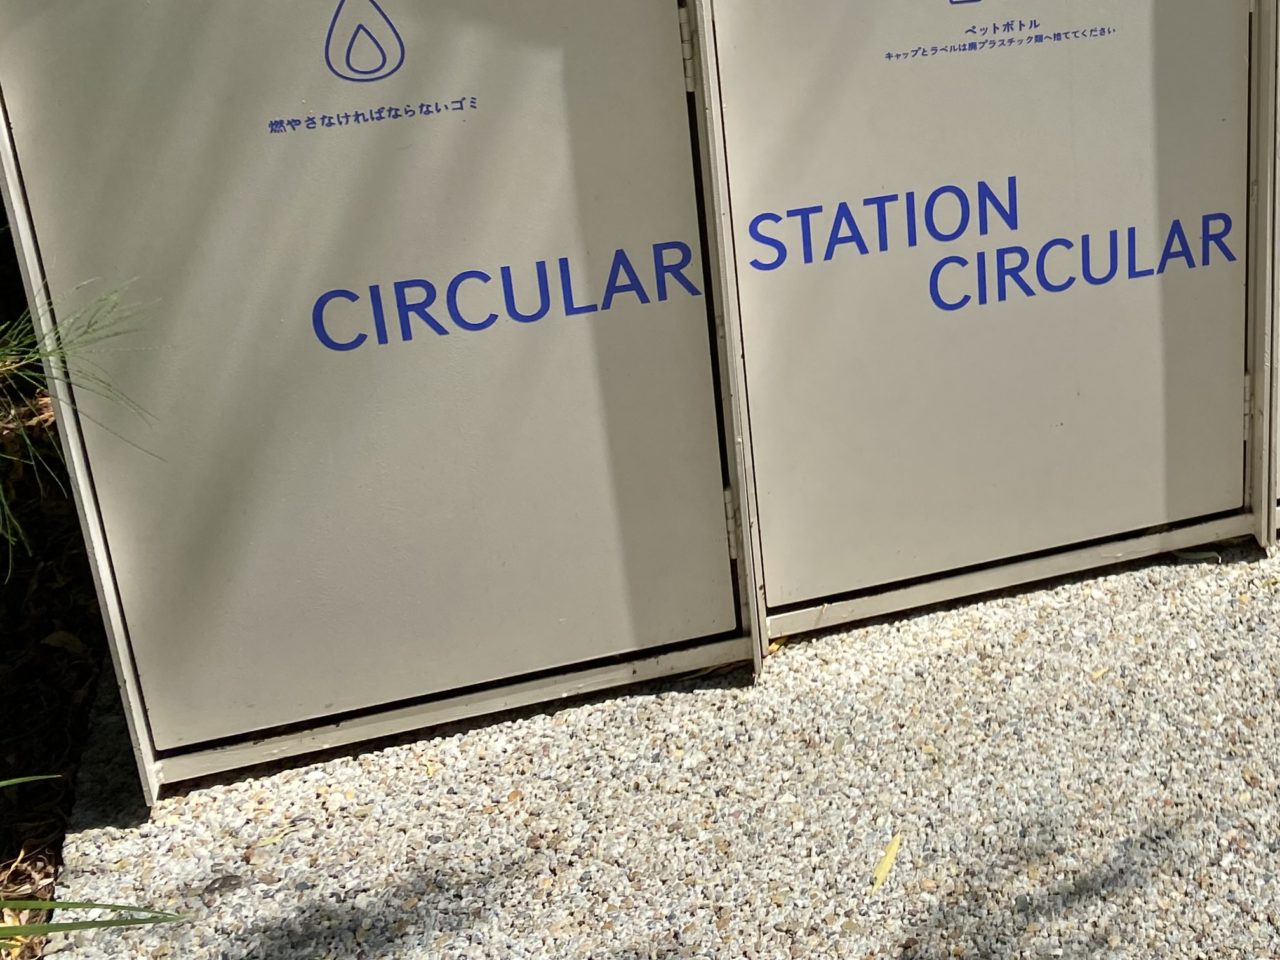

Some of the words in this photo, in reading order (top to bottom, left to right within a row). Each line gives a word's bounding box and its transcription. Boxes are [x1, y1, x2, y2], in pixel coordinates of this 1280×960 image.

[965, 19, 1041, 35] ペットボトル
[268, 96, 478, 134] 燃やさなければならないゴミ
[749, 176, 1020, 271] STATION
[929, 212, 1237, 311] CIRCULAR
[312, 241, 703, 352] CIRCULAR
